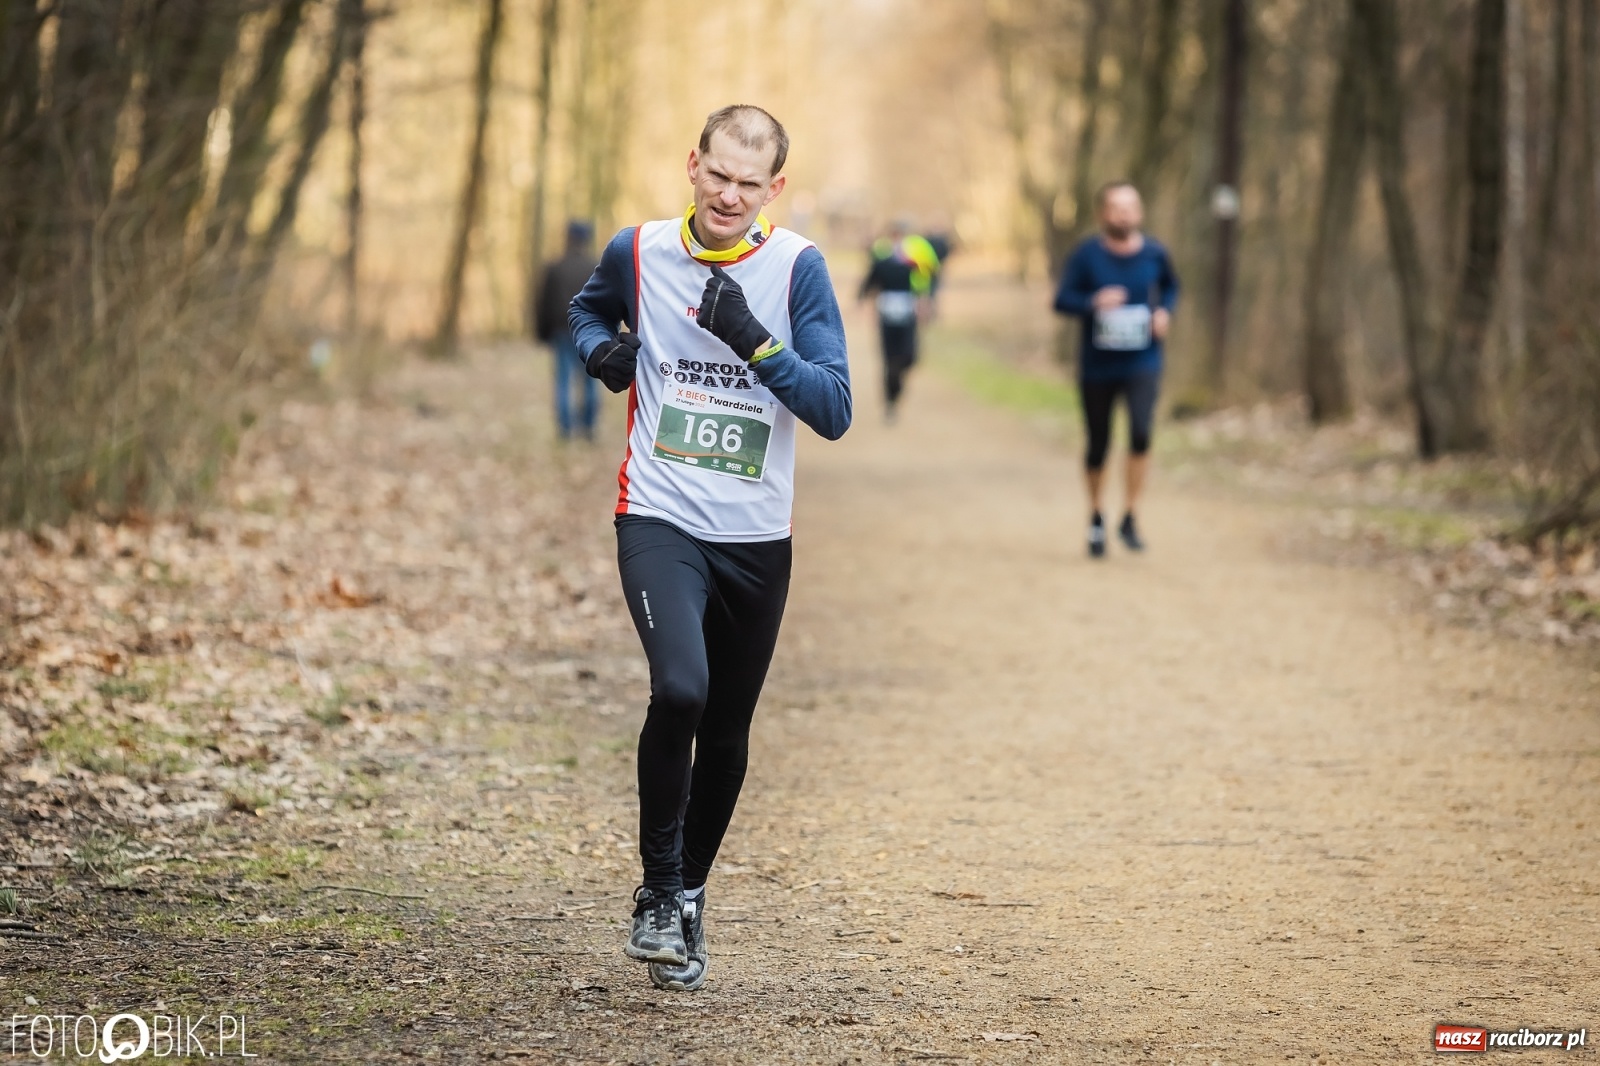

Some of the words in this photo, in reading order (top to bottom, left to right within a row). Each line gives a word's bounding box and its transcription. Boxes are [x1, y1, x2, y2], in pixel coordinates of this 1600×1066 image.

[677, 358, 747, 376] SOKOL
[674, 371, 752, 389] OPAVA
[676, 388, 684, 397] X
[685, 390, 707, 402] BIEG
[708, 395, 763, 414] Twardziela
[683, 414, 744, 453] 166
